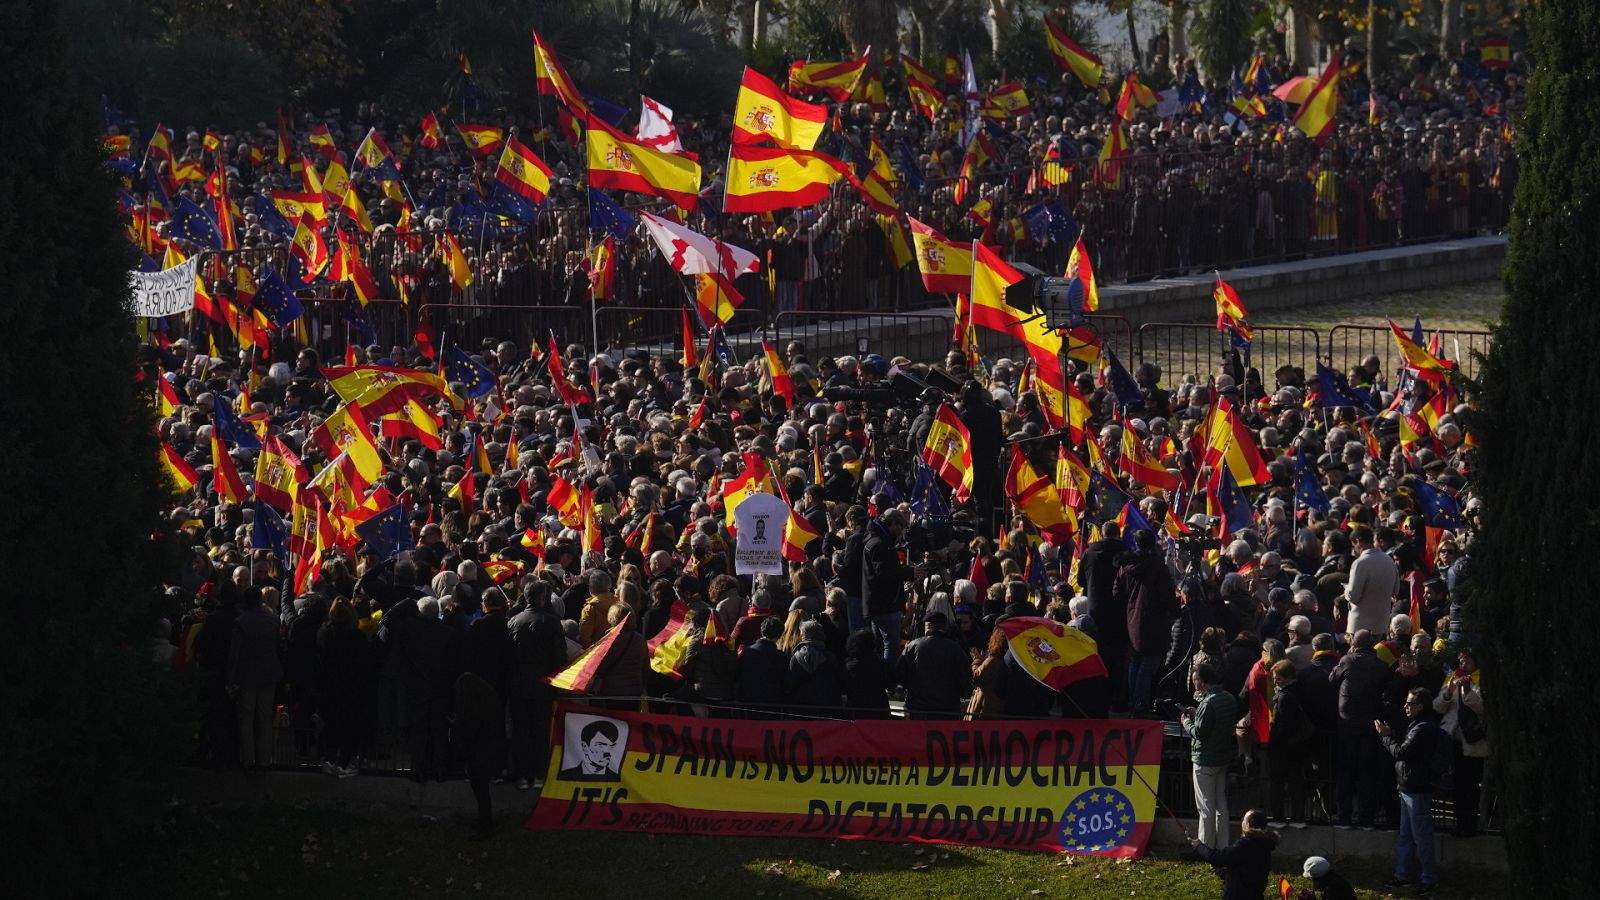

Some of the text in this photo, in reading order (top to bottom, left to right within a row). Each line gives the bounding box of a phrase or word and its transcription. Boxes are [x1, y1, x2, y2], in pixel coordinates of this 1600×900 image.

[634, 721, 1144, 787] SPAIN IS NO LONGER A DEMOCRACY
[559, 787, 1054, 845] IT'S BEGINNING TO BE A DICTATORSHIP
[1078, 811, 1117, 836] S.O.S.
